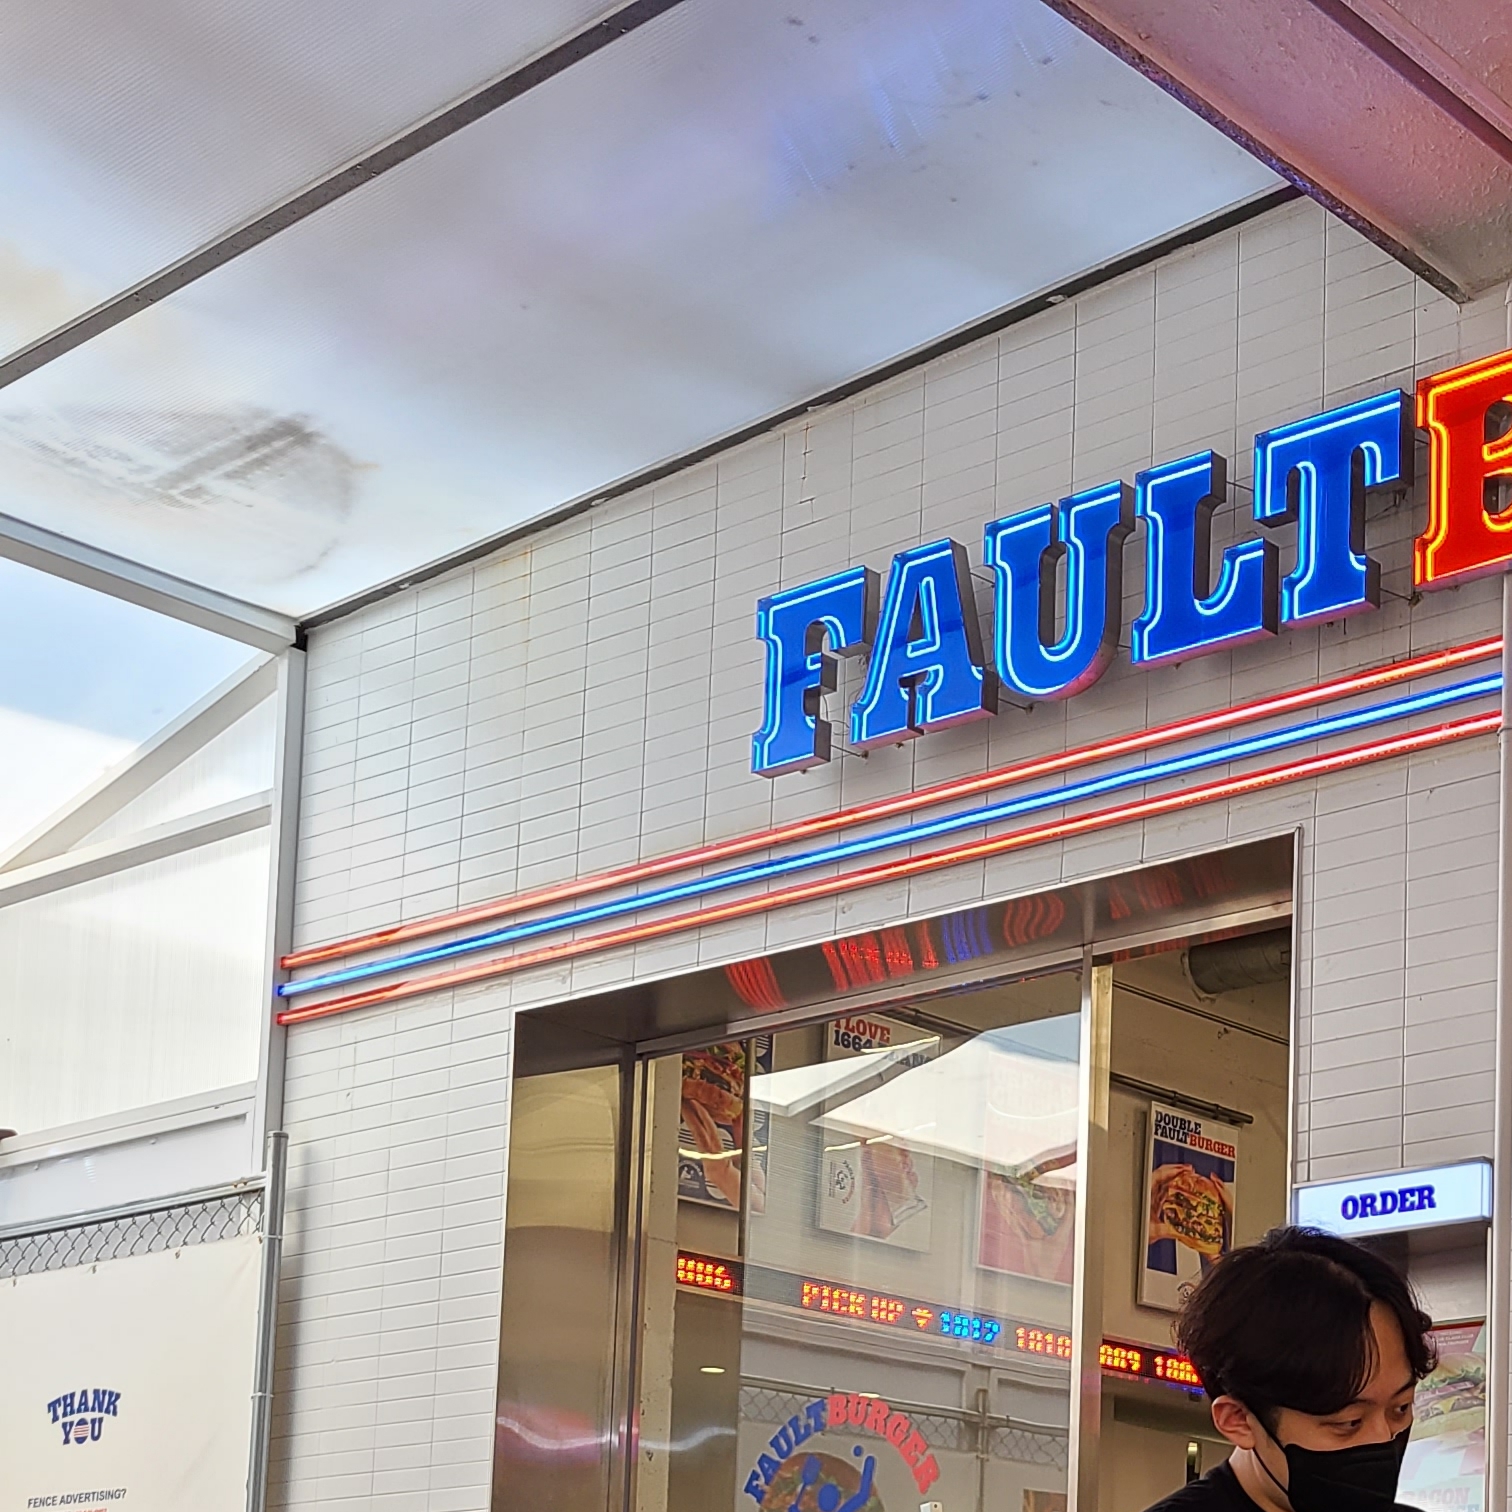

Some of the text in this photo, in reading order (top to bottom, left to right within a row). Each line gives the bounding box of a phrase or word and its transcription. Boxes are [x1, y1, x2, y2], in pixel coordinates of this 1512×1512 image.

[848, 1017, 891, 1044] LOVE
[1154, 1110, 1202, 1135] DOUBLE
[1154, 1124, 1236, 1159] FAULTBURGER
[1341, 1184, 1437, 1220] ORDER
[47, 1388, 121, 1424] THANK
[61, 1416, 104, 1445] YOU
[743, 1393, 940, 1496] FAULTBURGER
[27, 1488, 127, 1509] FENCE ADVERTISING?
